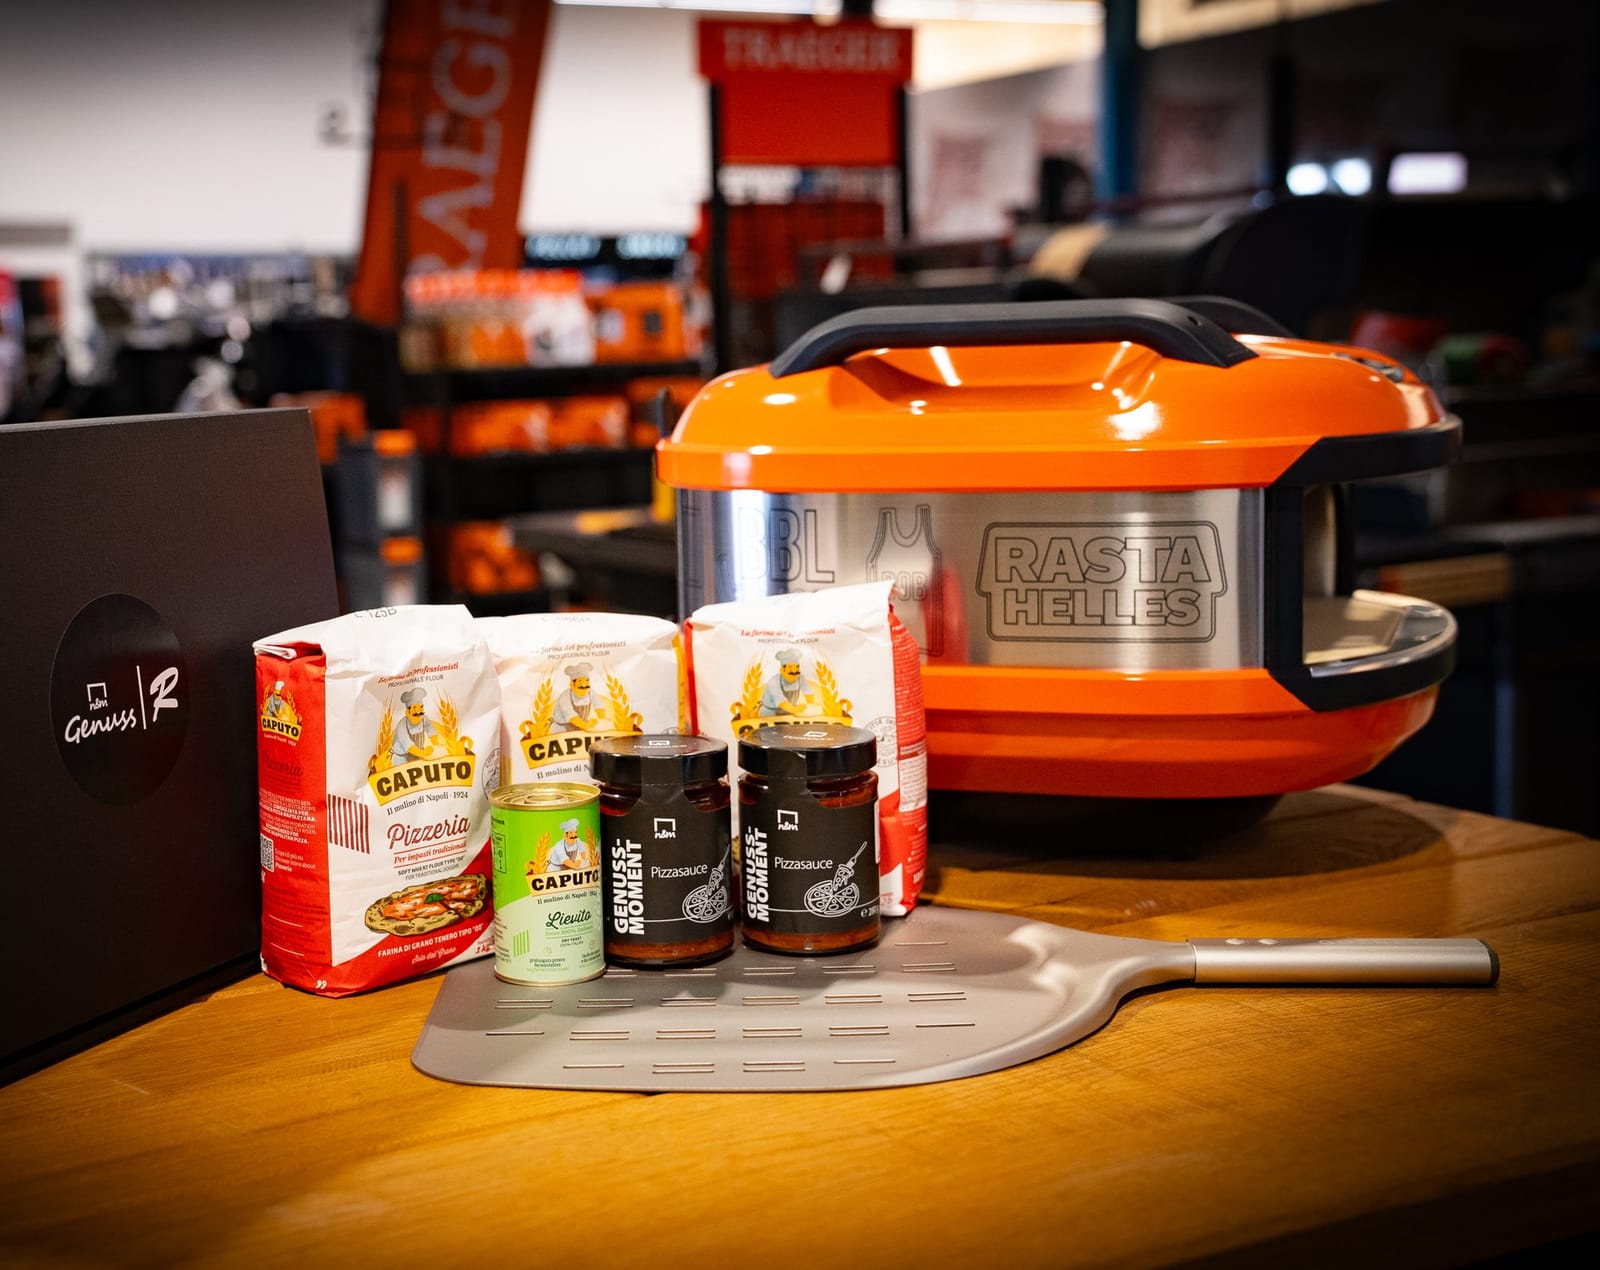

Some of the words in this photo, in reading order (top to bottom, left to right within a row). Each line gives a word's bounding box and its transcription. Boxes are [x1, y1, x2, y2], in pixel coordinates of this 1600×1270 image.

[995, 536, 1211, 584] RASTA
[1004, 588, 1201, 626] HELLES
[150, 666, 179, 723] R
[64, 708, 137, 744] Genuss
[262, 718, 299, 737] CAPUTO
[529, 735, 614, 761] CAP
[377, 761, 471, 796] CAPUTO
[545, 766, 572, 777] mulino
[574, 763, 582, 771] di
[387, 807, 394, 815] Il
[394, 800, 417, 812] mulino
[418, 796, 424, 804] di
[426, 791, 449, 802] Napoli
[453, 791, 468, 799] 1924
[387, 814, 471, 850] Pizzeria
[654, 829, 676, 839] n&m
[778, 821, 798, 831] n&m
[394, 856, 406, 864] Per
[408, 849, 431, 860] impasti
[411, 865, 428, 873] WHEAT
[429, 861, 443, 869] FLOUR
[774, 856, 833, 869] Pizzasauce
[531, 869, 599, 891] CAPUTO
[651, 864, 708, 878] Pizzasauce
[745, 826, 757, 919] GENUSS-
[754, 827, 770, 922] MOMENT
[612, 838, 629, 934] GENUSS-
[626, 839, 645, 935] MOMENT
[546, 909, 592, 929] Lievito
[378, 947, 403, 958] FARINA
[412, 938, 433, 949] GRANO
[434, 931, 458, 943] TENERO
[459, 928, 472, 937] TIPO
